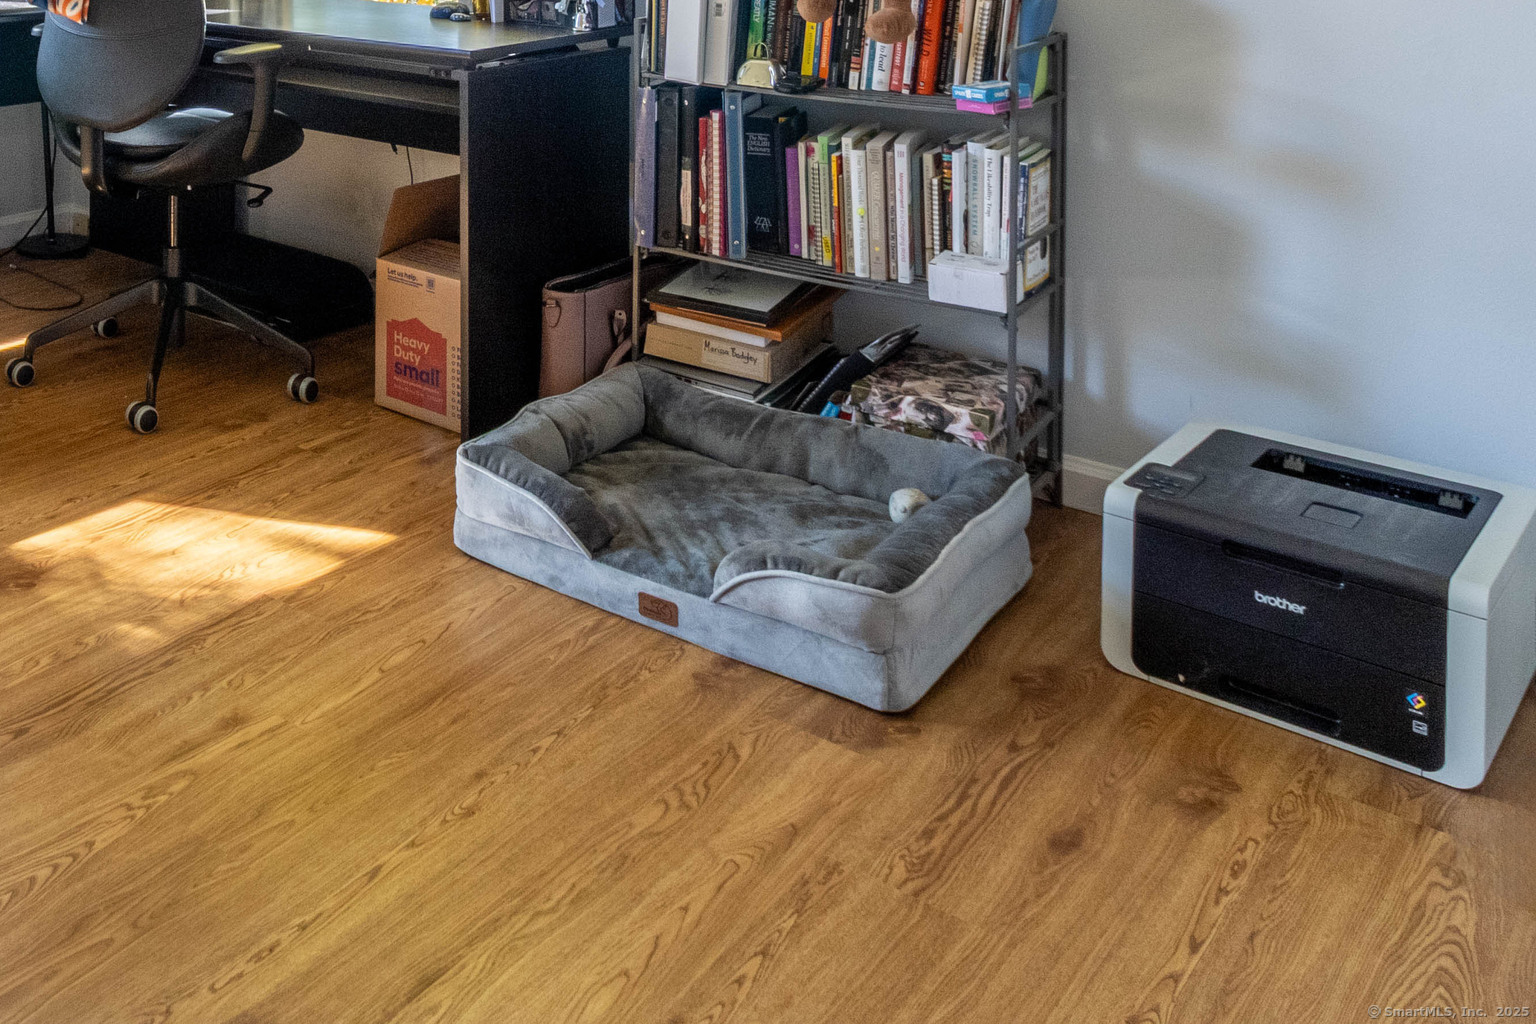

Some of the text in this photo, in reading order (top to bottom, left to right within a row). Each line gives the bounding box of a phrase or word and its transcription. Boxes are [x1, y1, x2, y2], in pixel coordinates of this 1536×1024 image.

[877, 44, 887, 72] to lead
[897, 172, 905, 209] Management
[971, 158, 979, 236] SNOWBALL SYSTEM
[985, 202, 993, 218] Trap
[823, 236, 831, 254] USED
[387, 267, 396, 275] Let
[404, 272, 418, 282] help.
[394, 330, 431, 354] Heavy
[394, 344, 421, 366] Duty
[394, 361, 440, 388] small
[1254, 590, 1307, 615] brother
